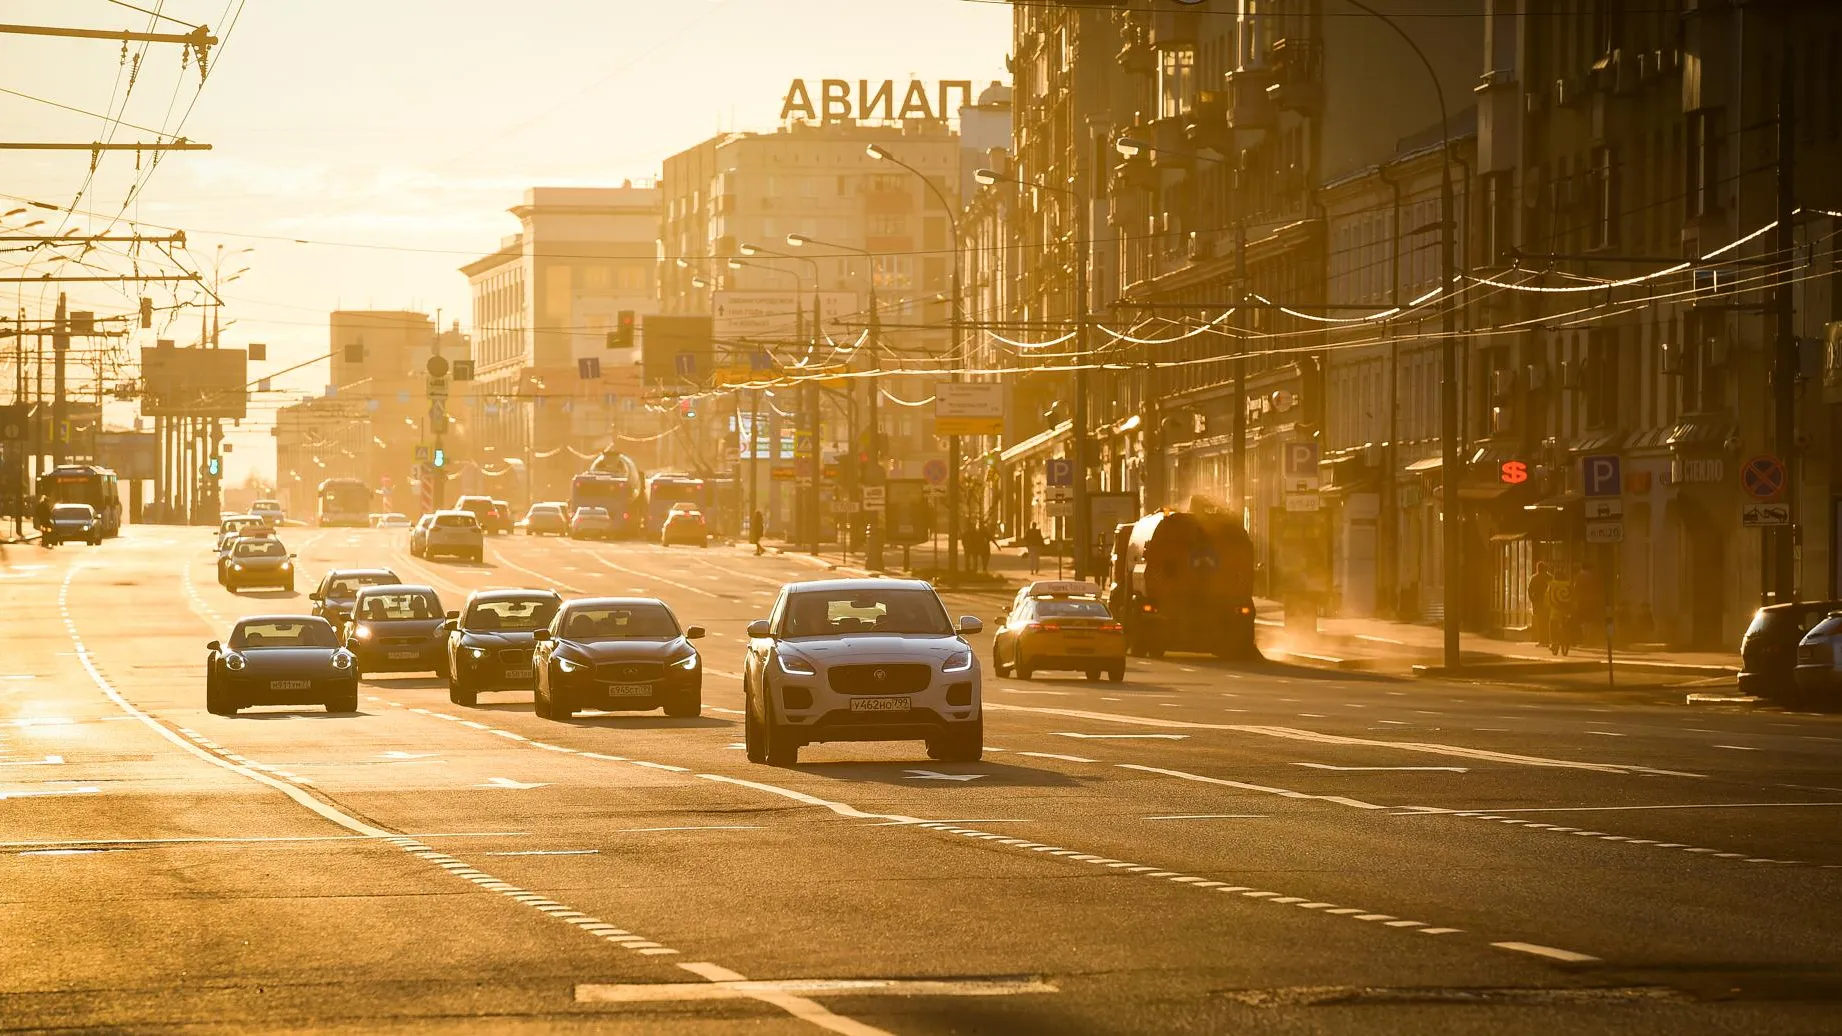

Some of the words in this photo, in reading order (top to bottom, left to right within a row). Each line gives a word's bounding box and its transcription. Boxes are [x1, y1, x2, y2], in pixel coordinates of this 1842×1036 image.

[780, 78, 972, 121] АВИАП
[1054, 462, 1069, 482] P
[1293, 446, 1311, 472] P
[1501, 461, 1528, 484] $
[1593, 460, 1613, 493] P
